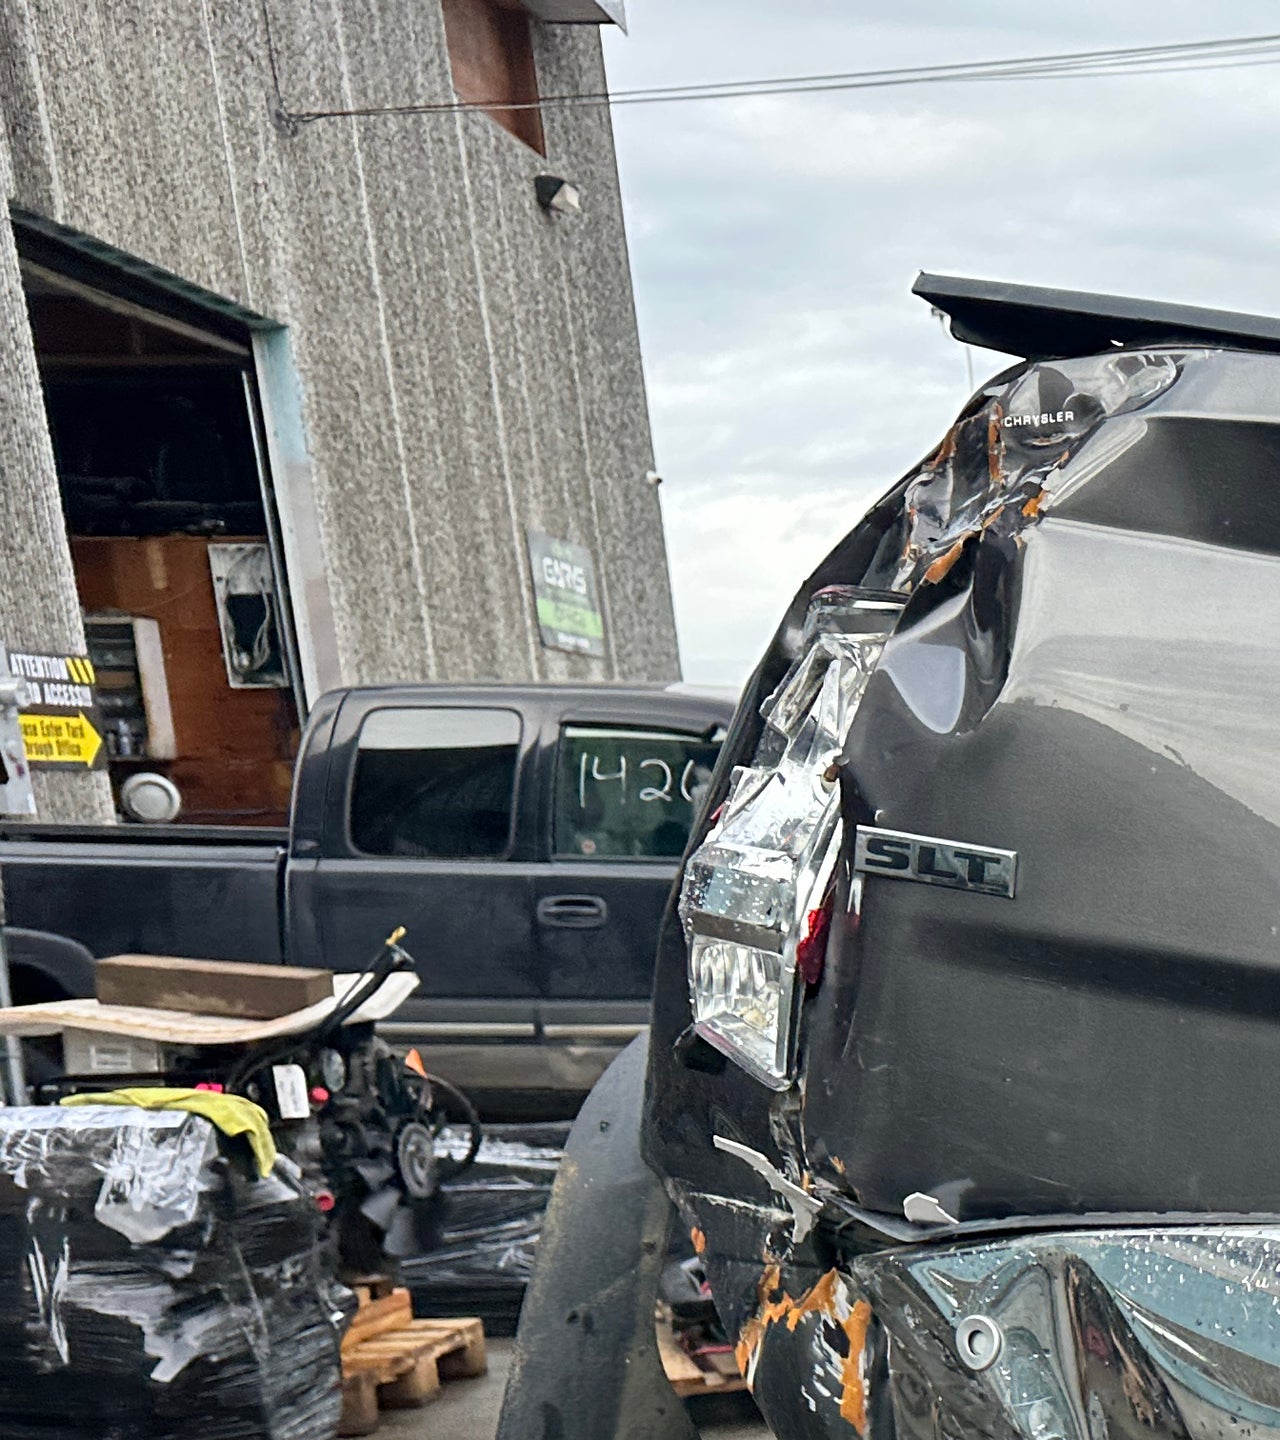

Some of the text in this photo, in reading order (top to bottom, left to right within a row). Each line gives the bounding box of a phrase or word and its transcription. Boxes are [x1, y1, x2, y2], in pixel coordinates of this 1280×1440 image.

[1004, 410, 1074, 428] CHRYSLER
[9, 652, 70, 681] ATTENTION
[864, 837, 1002, 885] SLT
